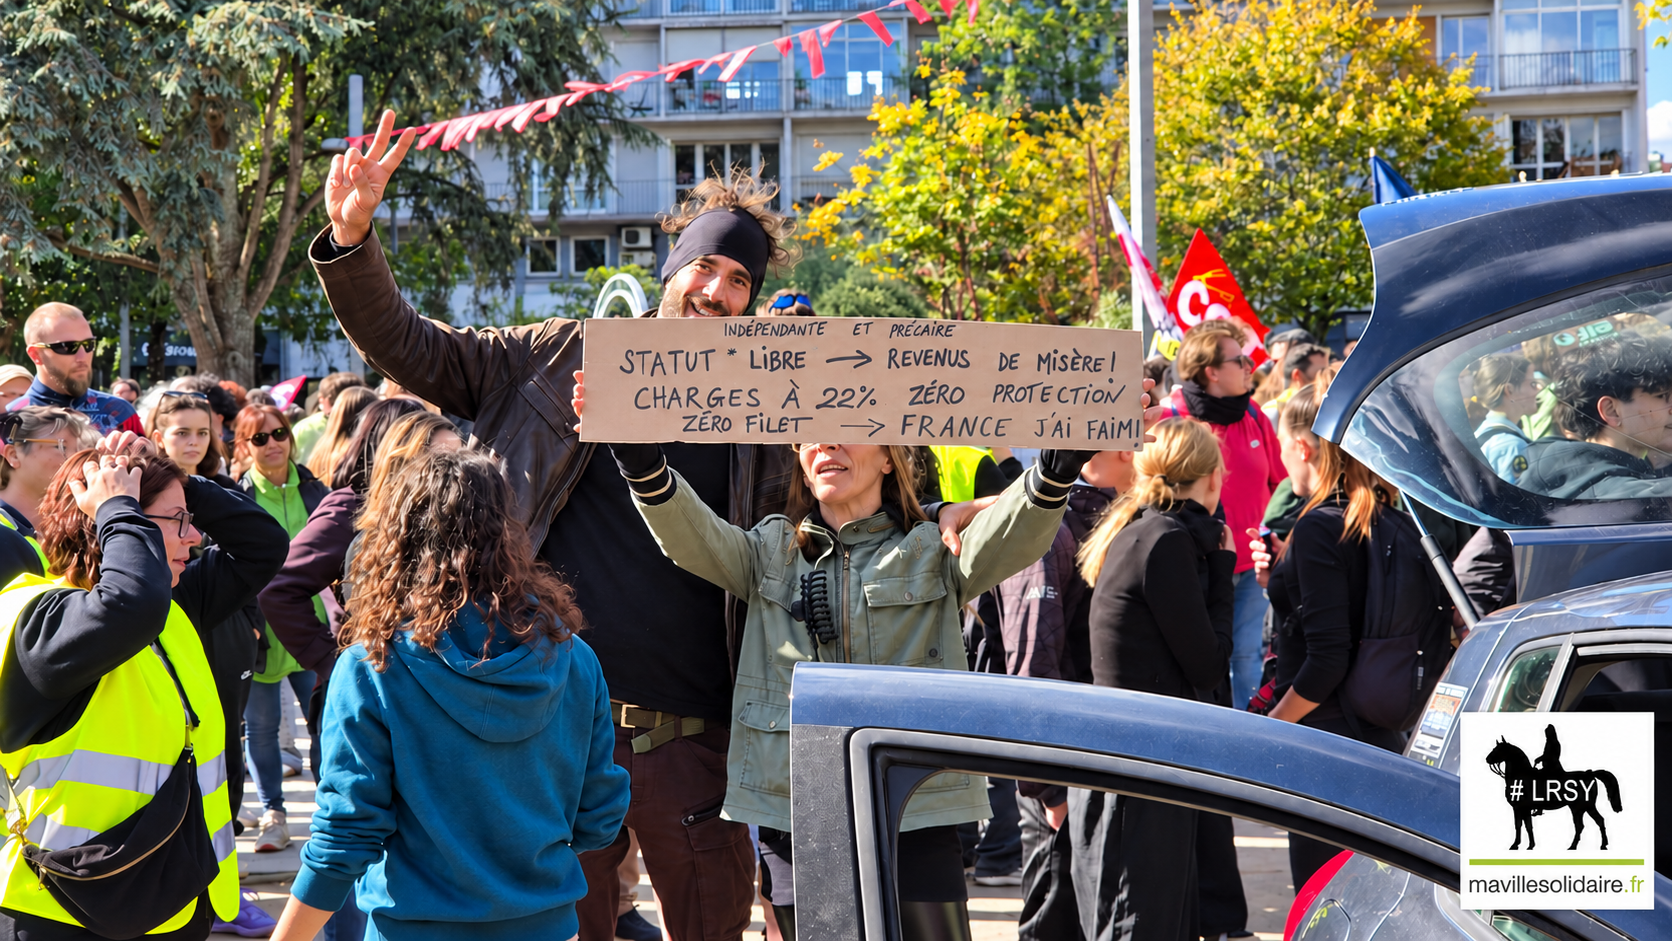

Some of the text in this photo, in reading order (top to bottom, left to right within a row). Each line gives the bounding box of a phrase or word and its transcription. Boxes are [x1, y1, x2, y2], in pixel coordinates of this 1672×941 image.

[725, 319, 827, 337] INDÉPENDANTE
[853, 322, 873, 335] ET
[620, 349, 715, 376] STATUT
[888, 348, 970, 369] REVENUS
[999, 352, 1020, 371] DE
[635, 386, 760, 409] CHARGES
[782, 379, 800, 409] À
[816, 386, 876, 409] 22%
[909, 380, 965, 405] ZÉRO
[683, 411, 732, 433] ZÉRO
[902, 414, 1012, 437] FRANCE
